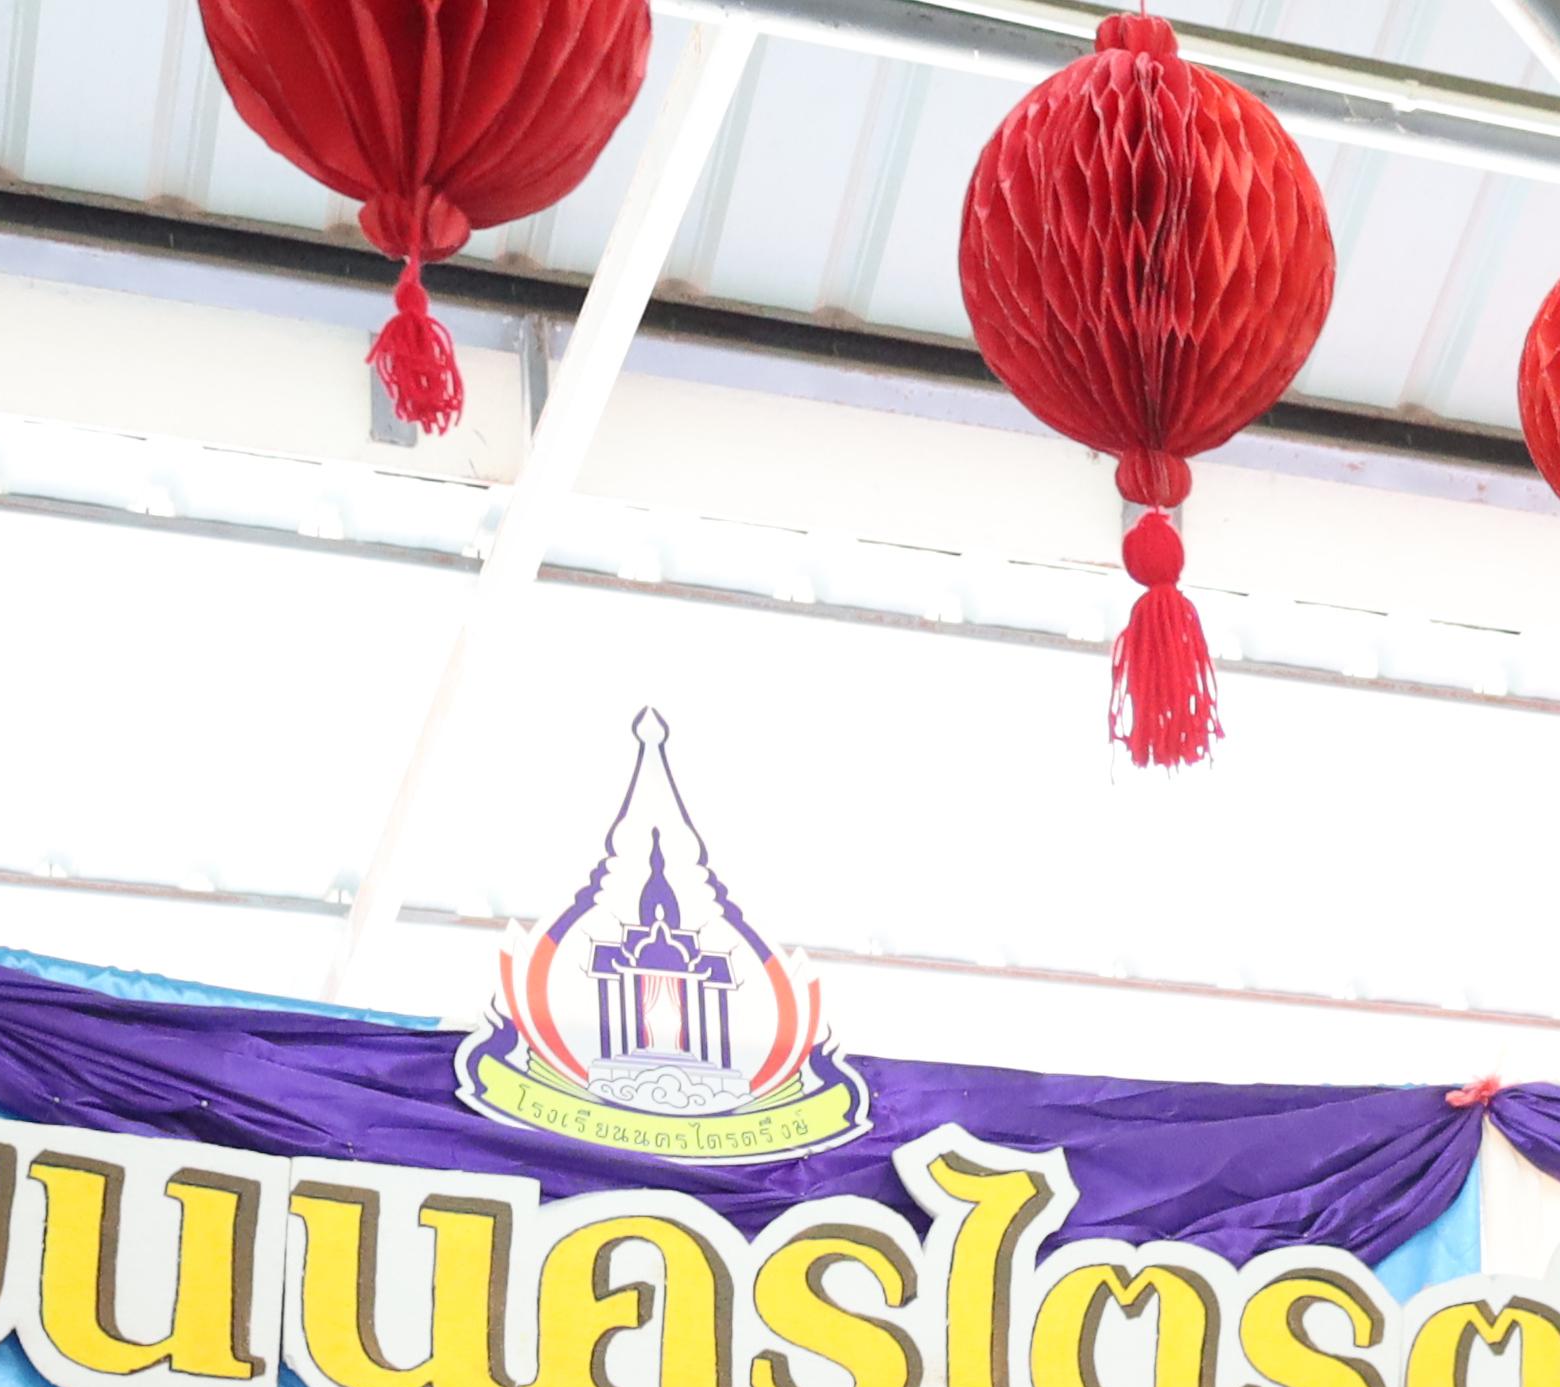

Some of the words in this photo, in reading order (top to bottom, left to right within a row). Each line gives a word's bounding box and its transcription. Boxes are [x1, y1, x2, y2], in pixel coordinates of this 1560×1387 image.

[515, 1083, 811, 1150] โรงเรียนนครไตรตรึงษ์
